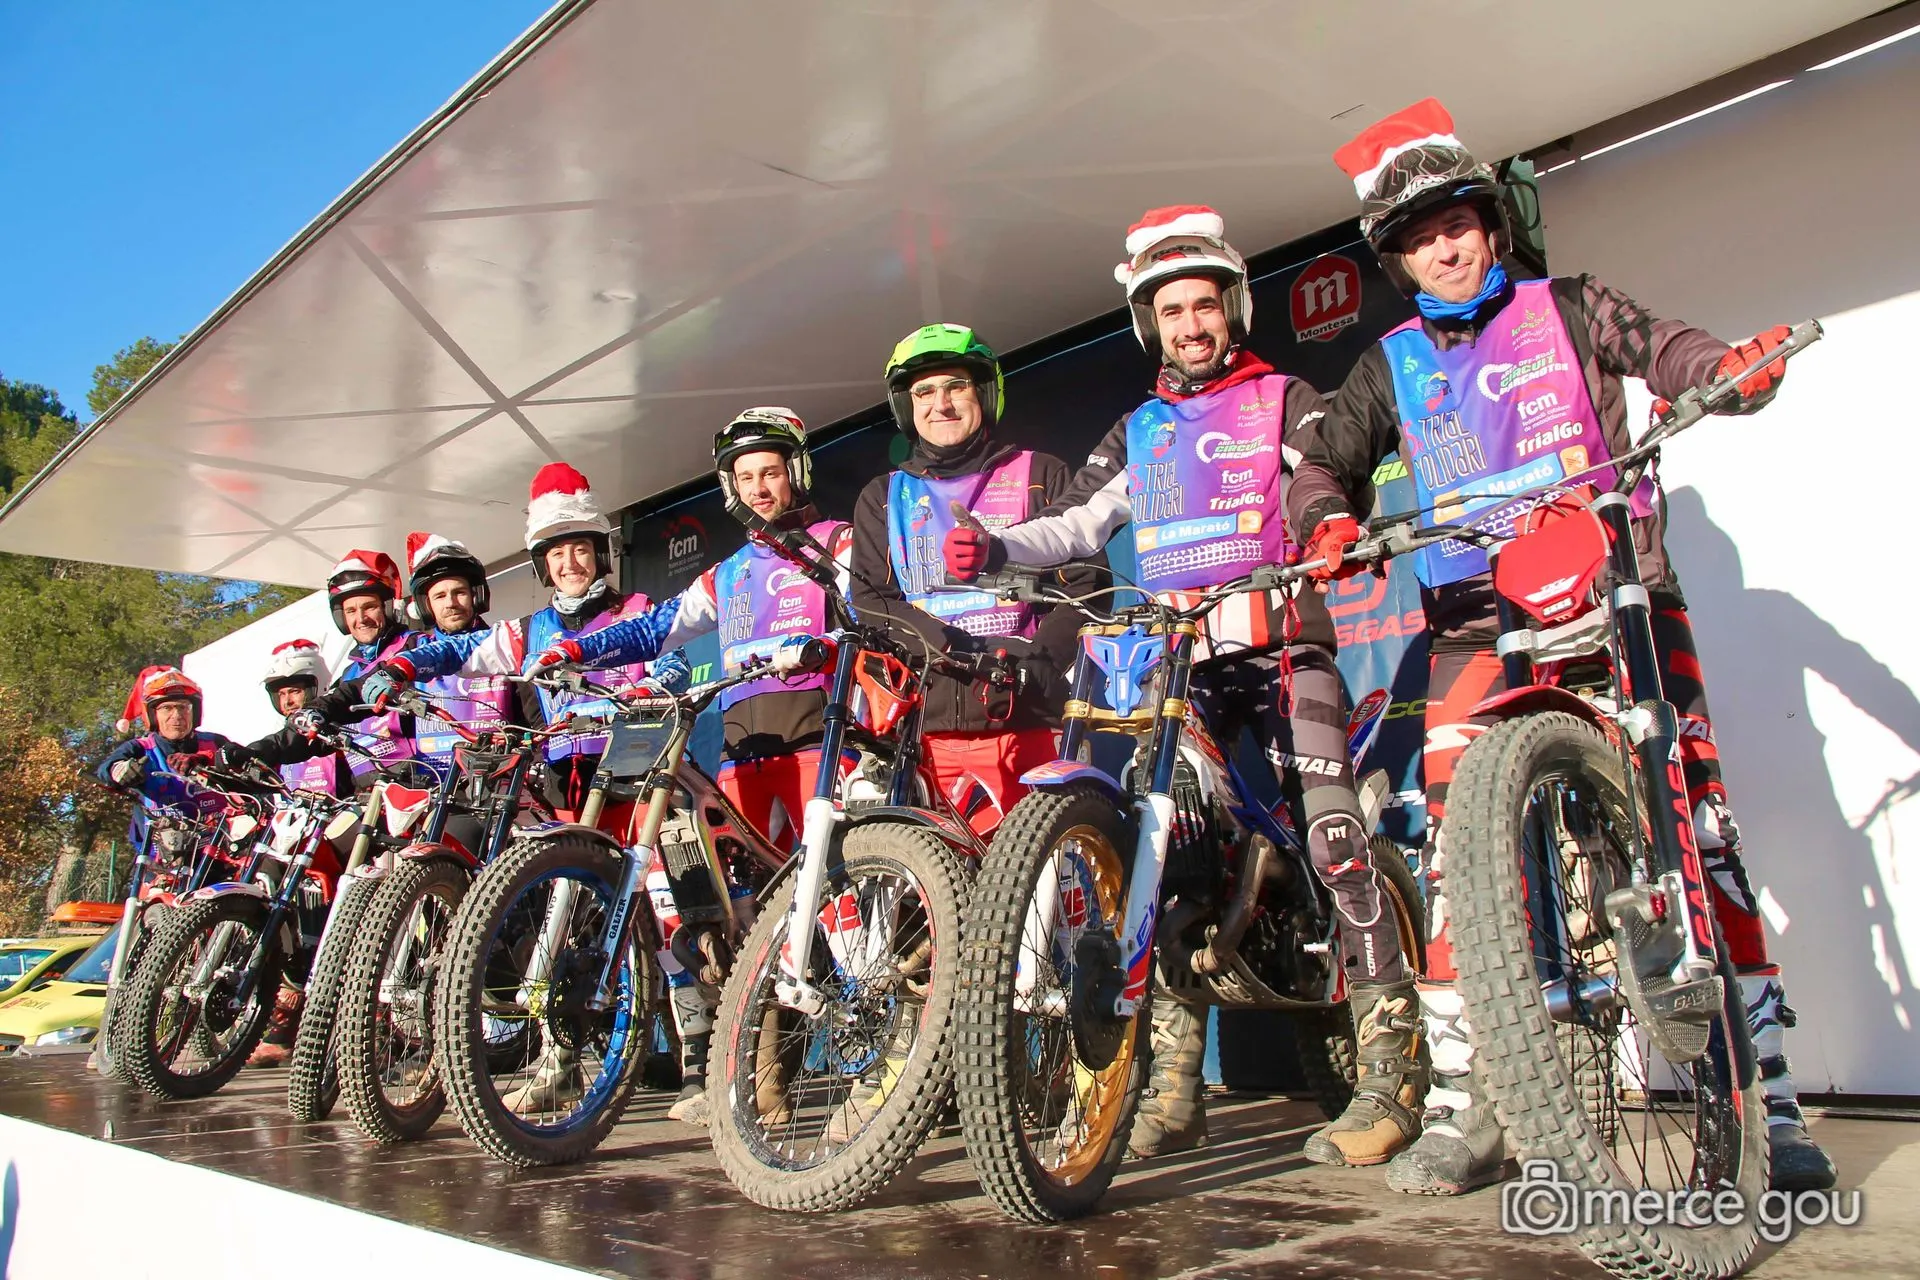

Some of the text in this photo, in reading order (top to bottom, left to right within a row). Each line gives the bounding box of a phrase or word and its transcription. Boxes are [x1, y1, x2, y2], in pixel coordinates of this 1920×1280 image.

[1300, 316, 1354, 340] Montesa
[1501, 354, 1556, 388] CIRCUIT
[1517, 392, 1558, 420] fcm
[1214, 440, 1263, 454] CIRCUIT
[1516, 421, 1583, 457] TrialGo
[1221, 468, 1253, 484] fcm
[1487, 463, 1555, 496] Marató
[1210, 491, 1265, 511] TrialGo
[1161, 519, 1231, 541] La Marató
[669, 535, 698, 560] fcm
[779, 596, 802, 609] fcm
[769, 615, 812, 632] TrialGo
[200, 799, 216, 807] fcm
[608, 899, 627, 939] GALFER
[1363, 933, 1376, 977] COMAS
